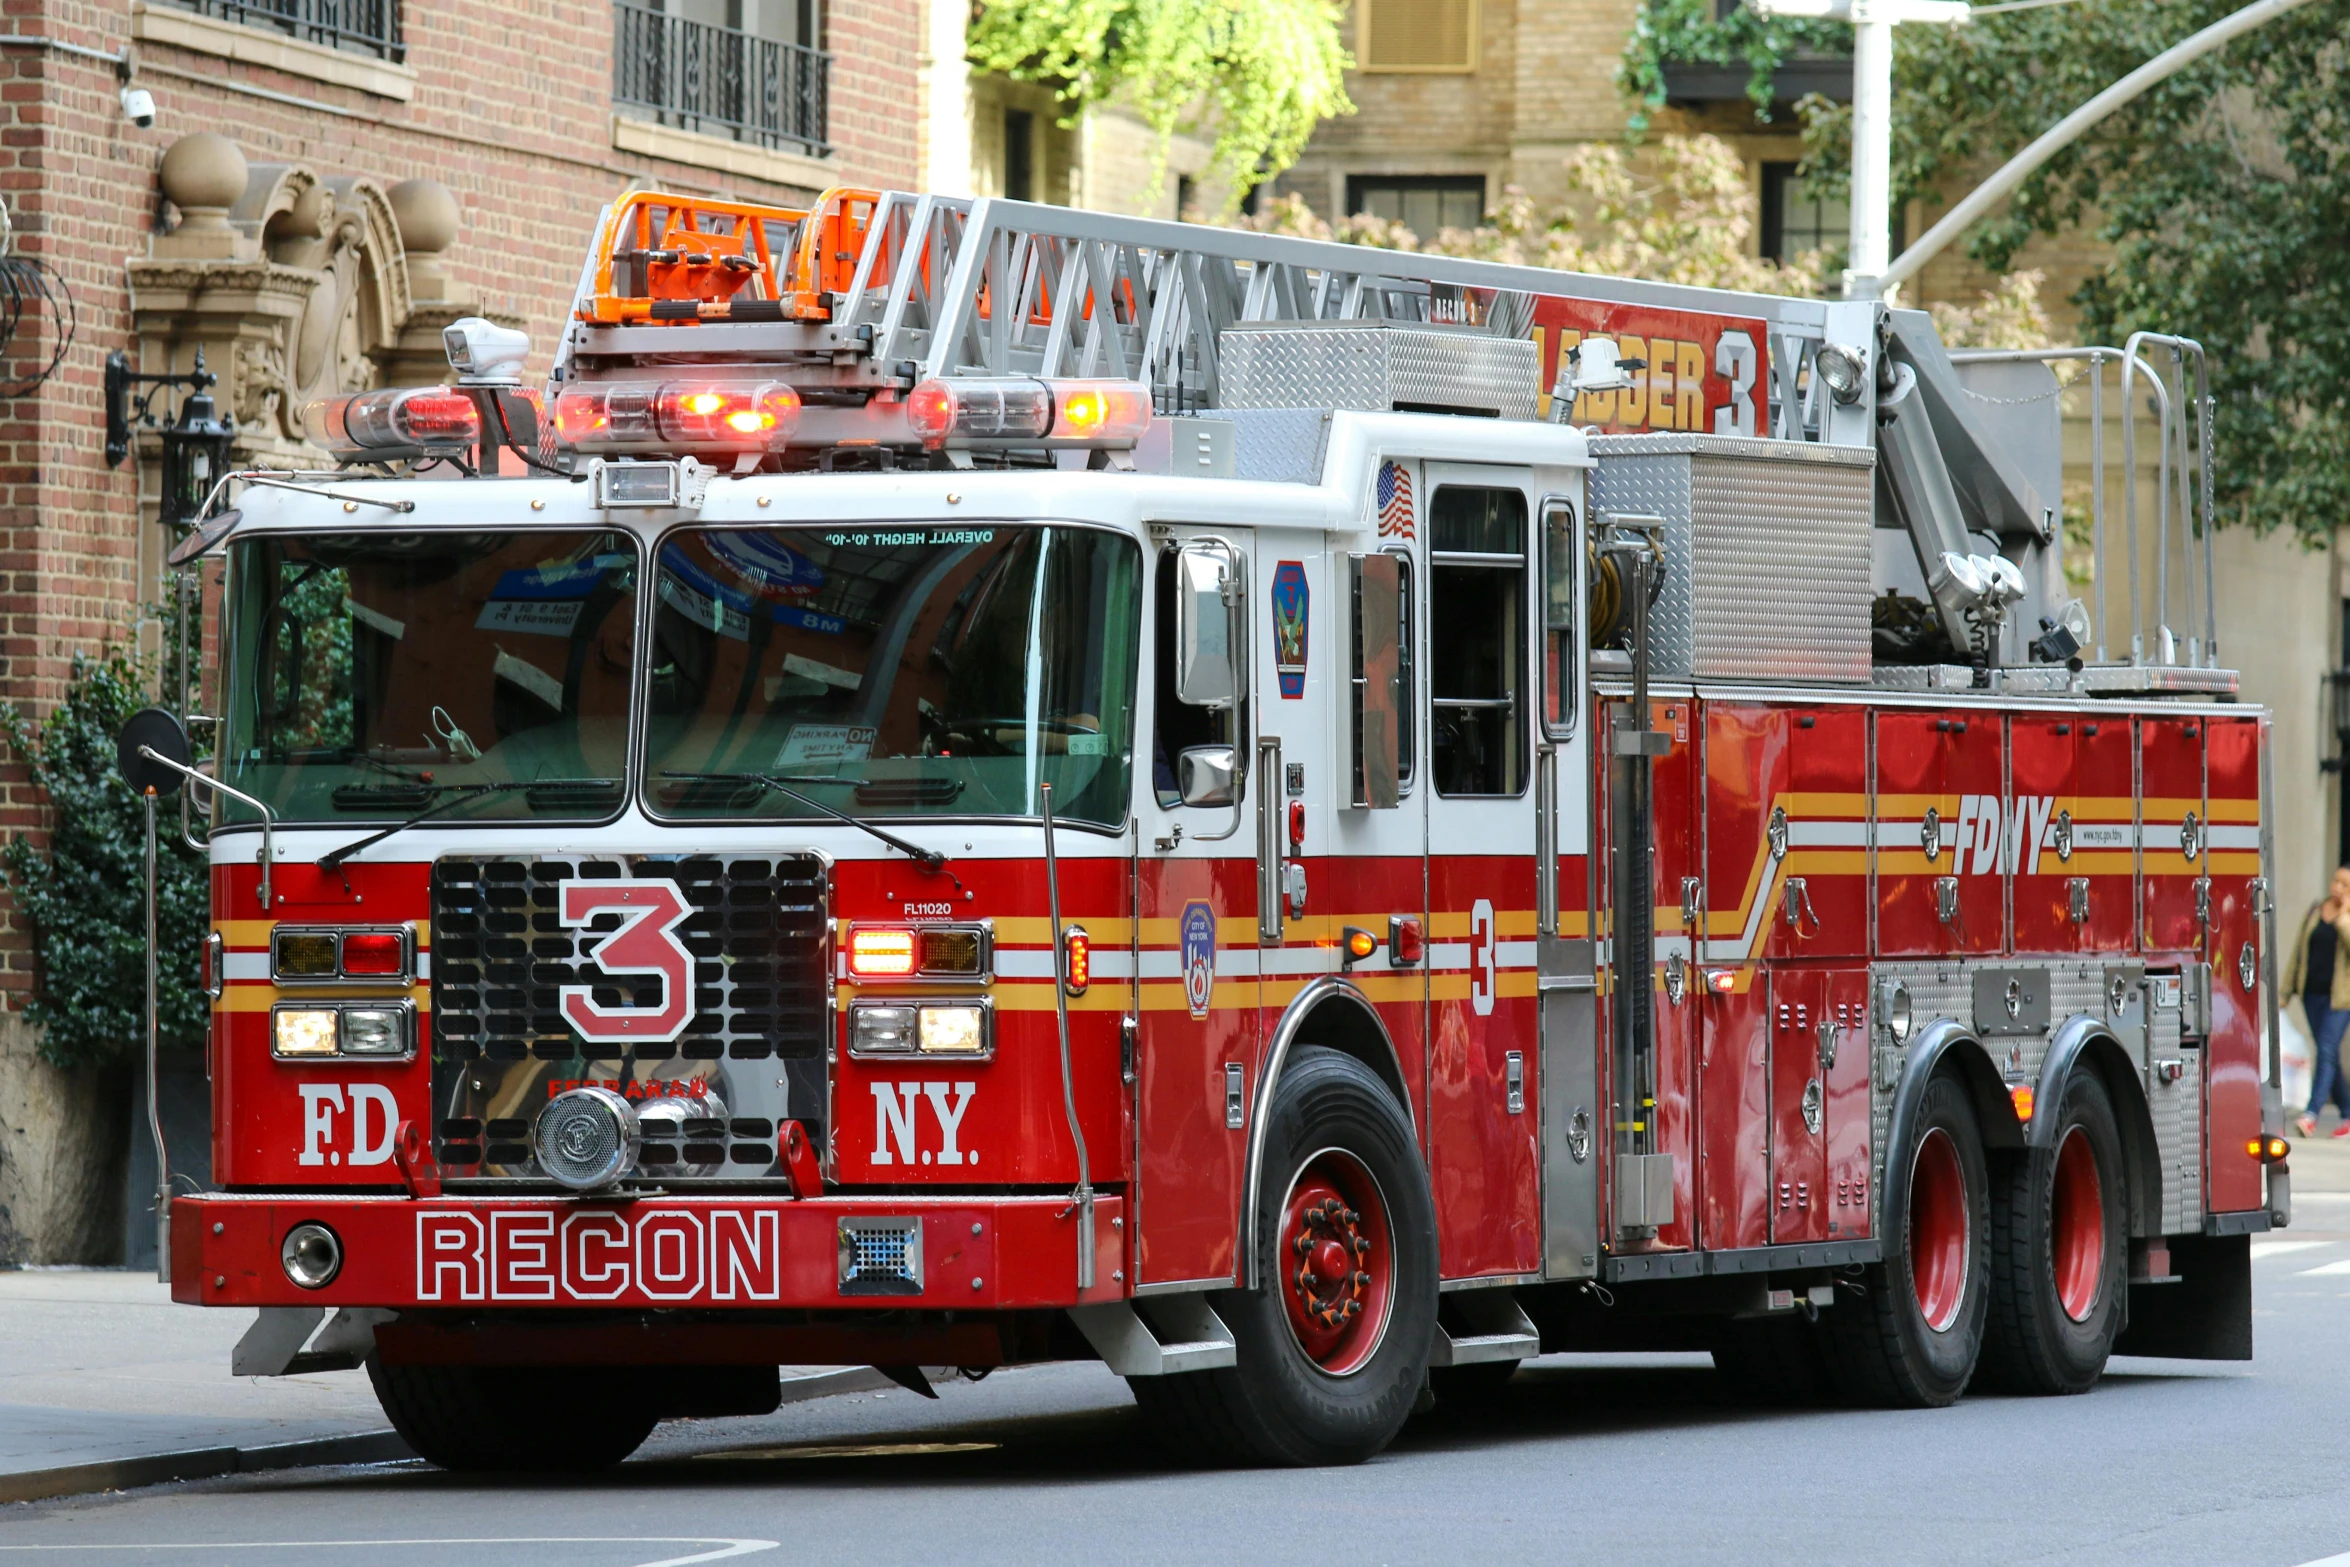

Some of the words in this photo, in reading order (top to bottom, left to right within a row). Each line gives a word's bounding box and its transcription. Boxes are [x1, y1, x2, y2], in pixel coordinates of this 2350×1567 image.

[1436, 298, 1466, 322] RECON
[1470, 302, 1476, 322] 3
[1714, 328, 1757, 437] 3
[1953, 794, 2054, 876] FDNY
[904, 903, 952, 915] FL11020
[1189, 932, 1198, 941] NEW
[1198, 932, 1209, 941] YORK
[1191, 922, 1200, 930] CITY
[1200, 921, 1205, 930] OF
[559, 878, 695, 1043] 3
[1472, 899, 1495, 1016] 3
[870, 1082, 979, 1166] N.Y.
[416, 1210, 780, 1300] RECON
